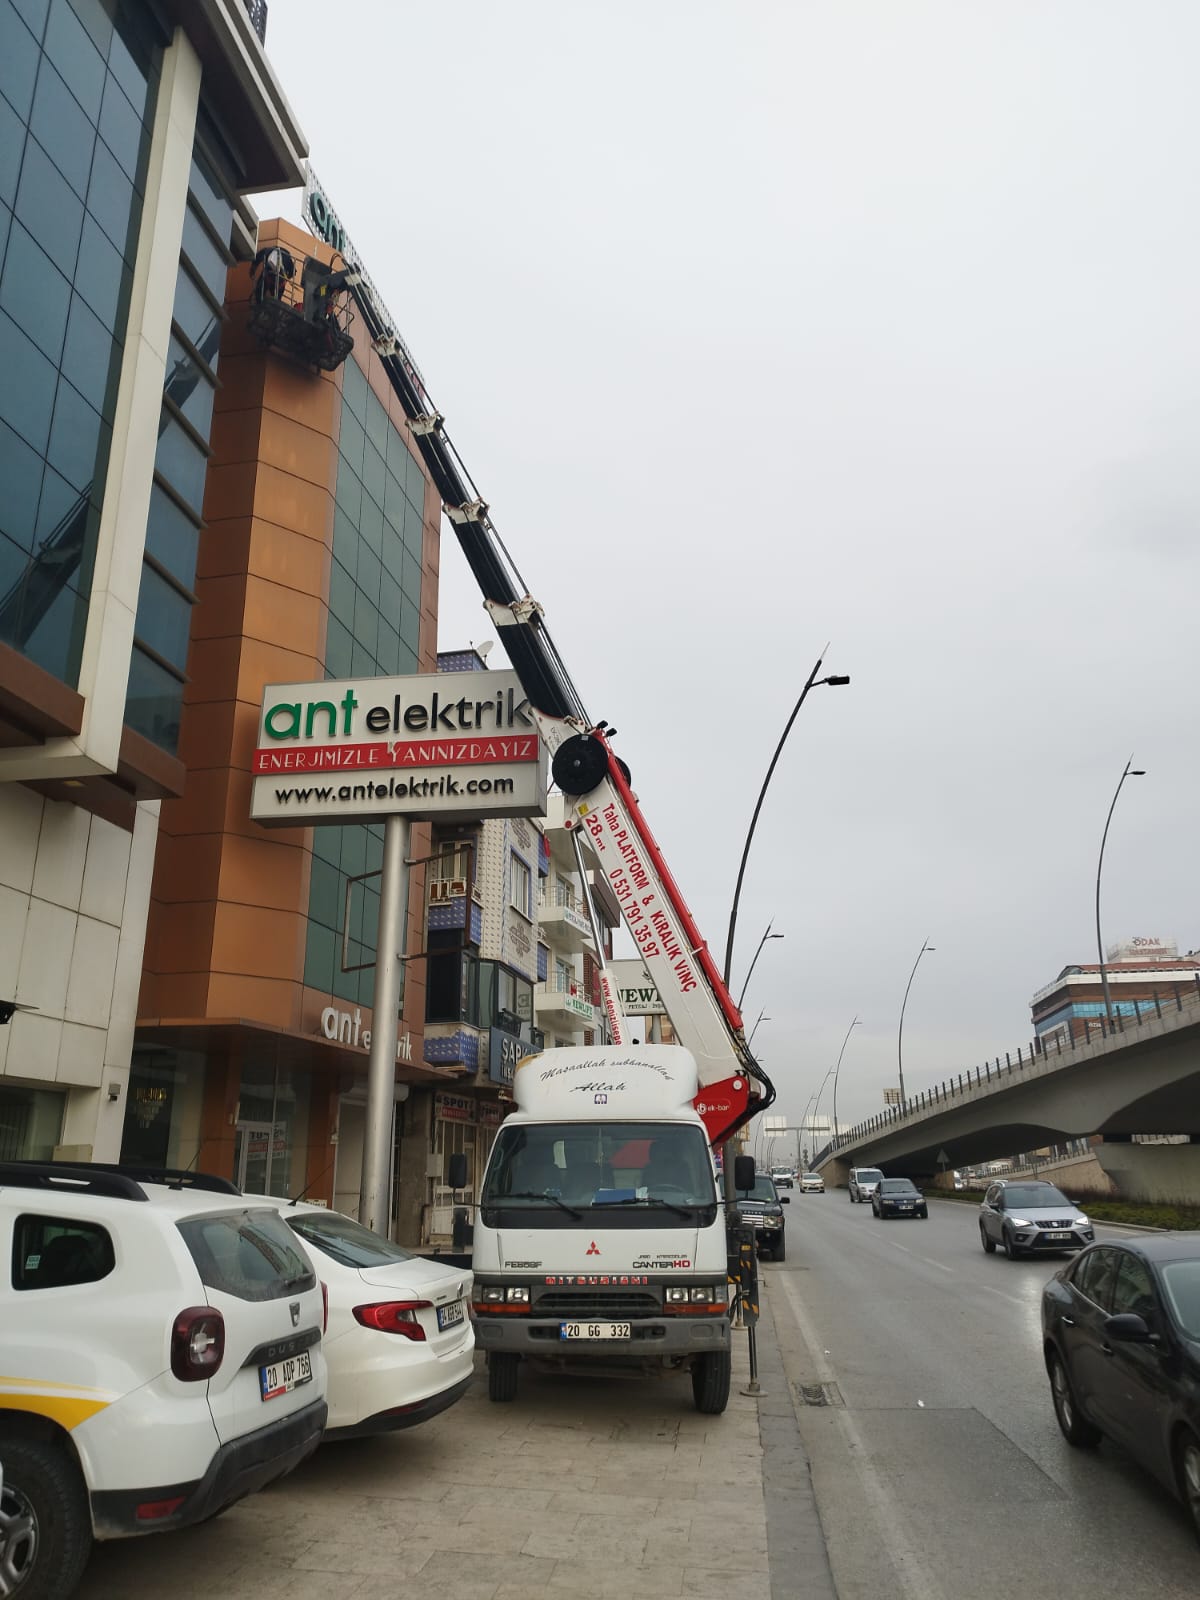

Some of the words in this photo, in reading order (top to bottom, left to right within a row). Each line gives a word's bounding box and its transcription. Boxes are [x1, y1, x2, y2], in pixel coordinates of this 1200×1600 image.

[264, 689, 358, 740] ant
[365, 687, 533, 734] elektrik
[389, 741, 532, 762] YANINIZDAYIZ
[274, 775, 514, 805] www.antelektrik.com
[603, 803, 620, 831] Taha
[614, 829, 650, 891] PLATFORM
[642, 893, 655, 906] &
[609, 868, 623, 879] 0
[613, 879, 633, 905] 531
[624, 901, 642, 926] 791
[634, 925, 652, 943] 35
[642, 942, 661, 959] 97
[600, 976, 623, 1046] www.denizlisepe
[321, 1006, 362, 1047] ant
[362, 1031, 413, 1061] erik
[569, 1082, 626, 1092] Allah
[545, 1276, 648, 1285] MITSUBISHI
[567, 1325, 580, 1337] 20
[588, 1325, 601, 1337] GG
[610, 1324, 630, 1337] 332
[267, 1367, 278, 1389] 20
